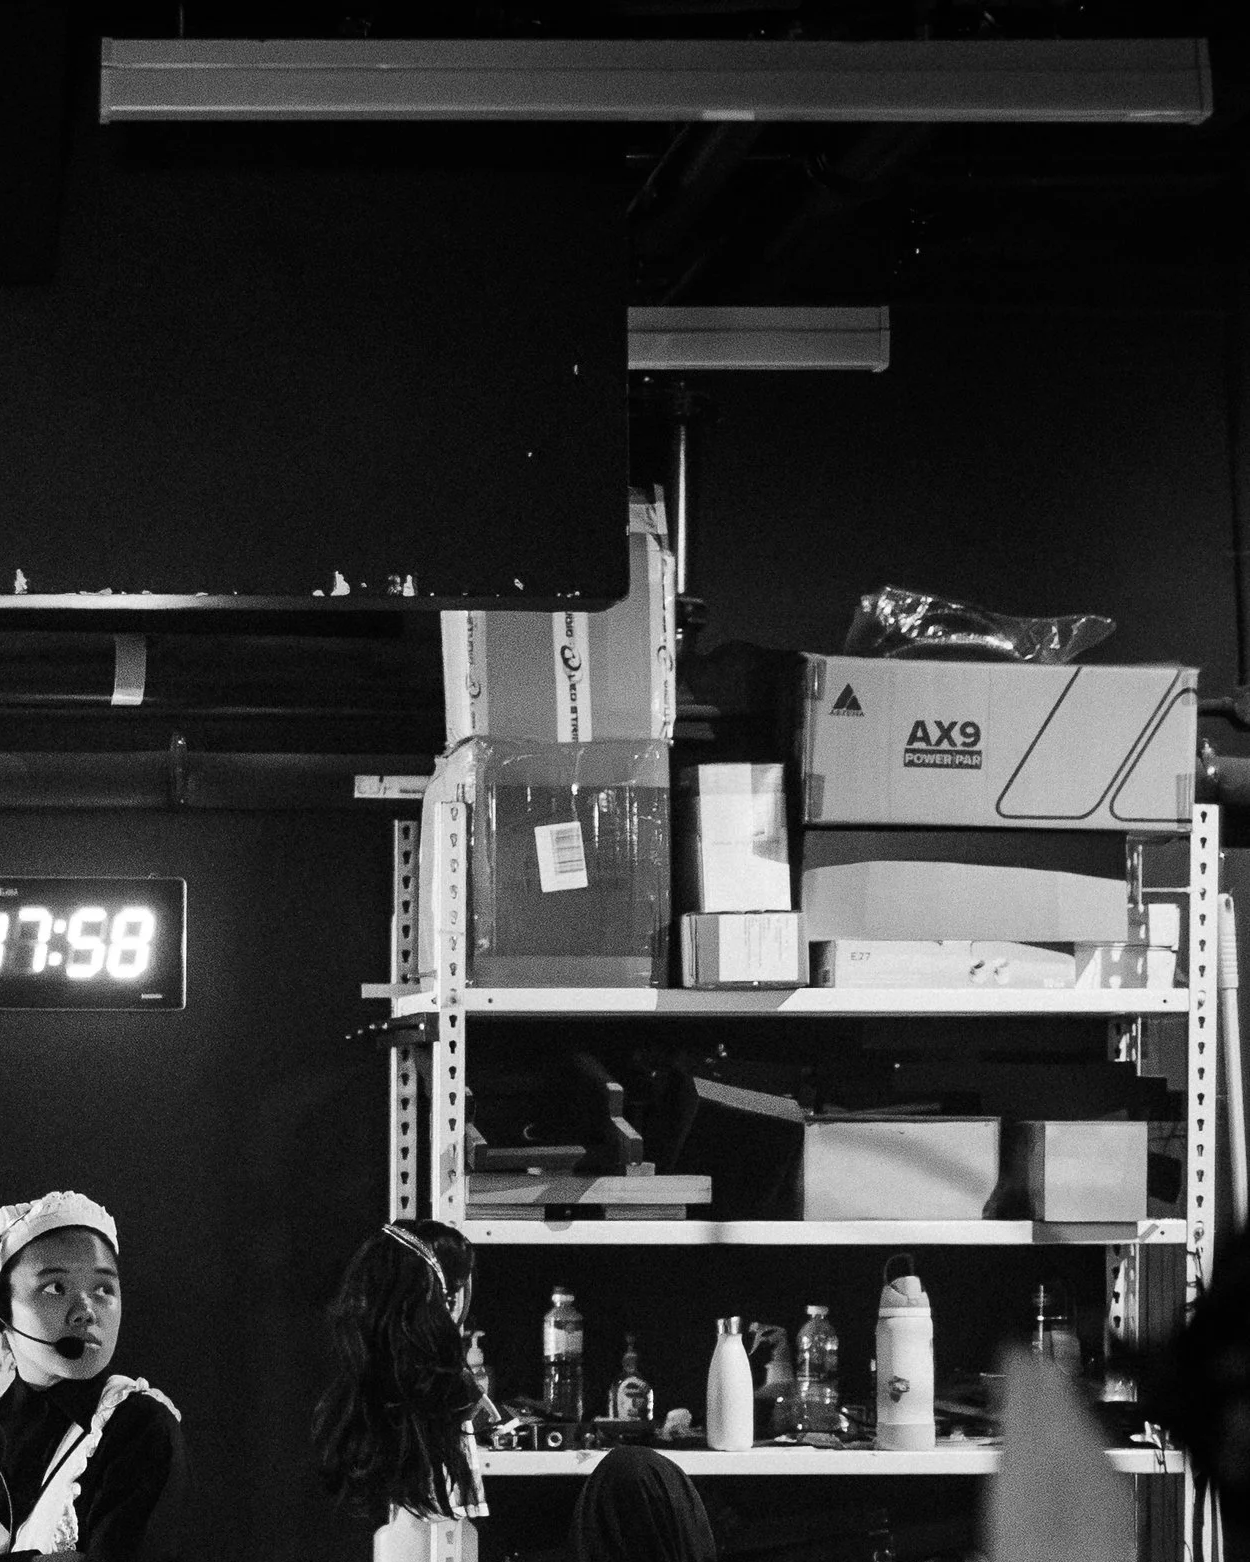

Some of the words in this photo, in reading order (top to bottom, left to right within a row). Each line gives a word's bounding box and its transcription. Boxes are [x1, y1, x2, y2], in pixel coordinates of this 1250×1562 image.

[906, 720, 982, 748] AX9
[905, 753, 952, 764] POWER
[955, 754, 981, 765] PAR
[851, 952, 871, 961] E27
